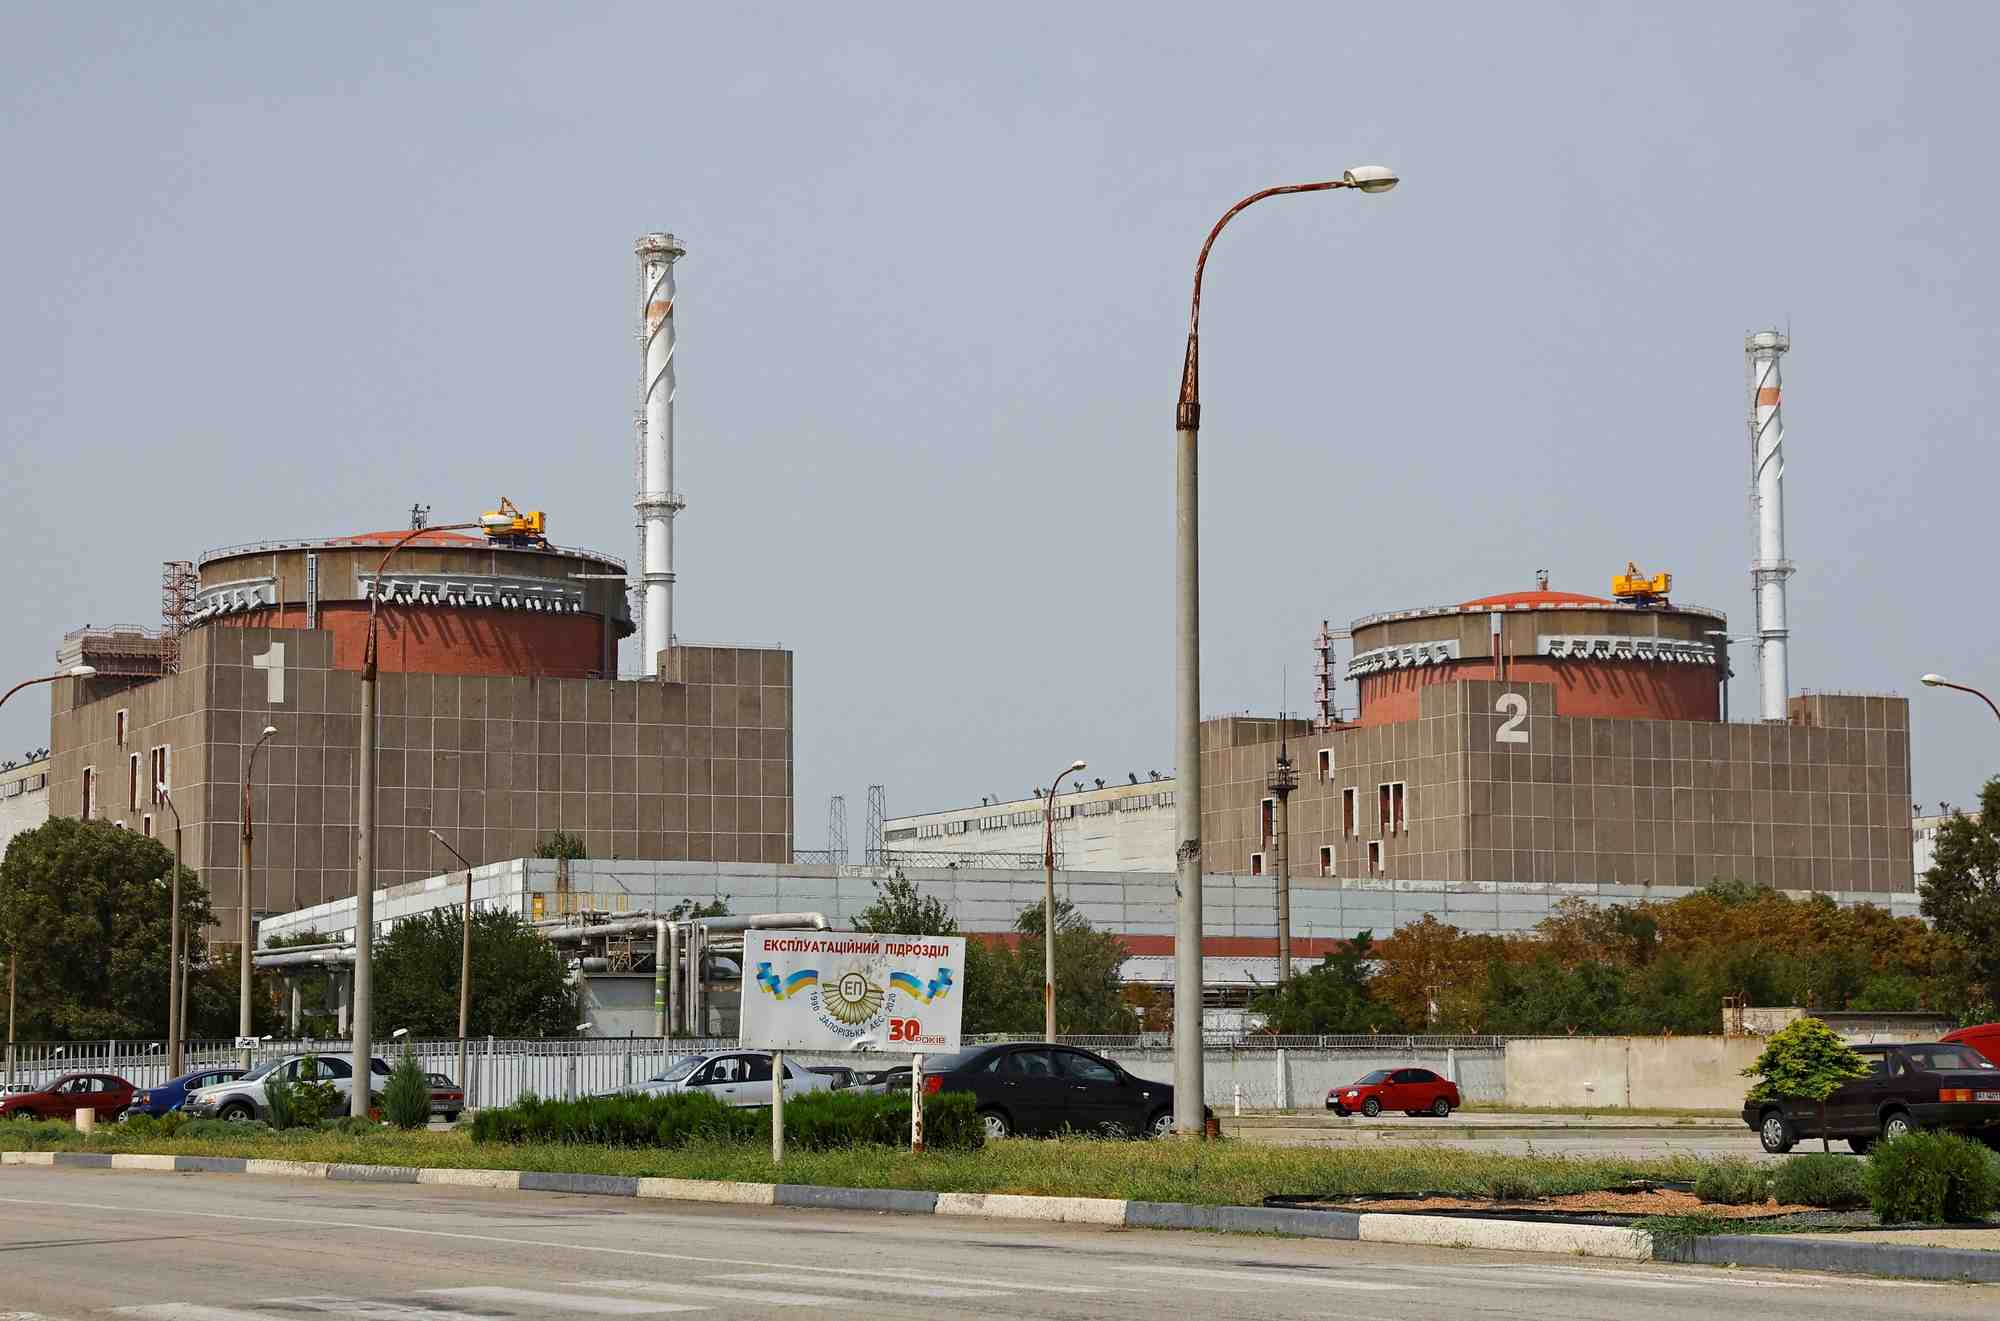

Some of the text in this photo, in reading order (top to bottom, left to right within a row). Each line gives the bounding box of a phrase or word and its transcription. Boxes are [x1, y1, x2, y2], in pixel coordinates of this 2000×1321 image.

[253, 642, 284, 703] 1
[1496, 693, 1528, 743] 2
[763, 939, 949, 958] ЕКСПЛУАТАЦІЙНИЙ ПІДРОЗДІЛ
[844, 981, 863, 996] ЕП
[819, 1014, 866, 1038] ЗАПОРІЗЬКА
[885, 993, 897, 1012] 2020
[888, 1018, 945, 1044] 30 РОКІВ
